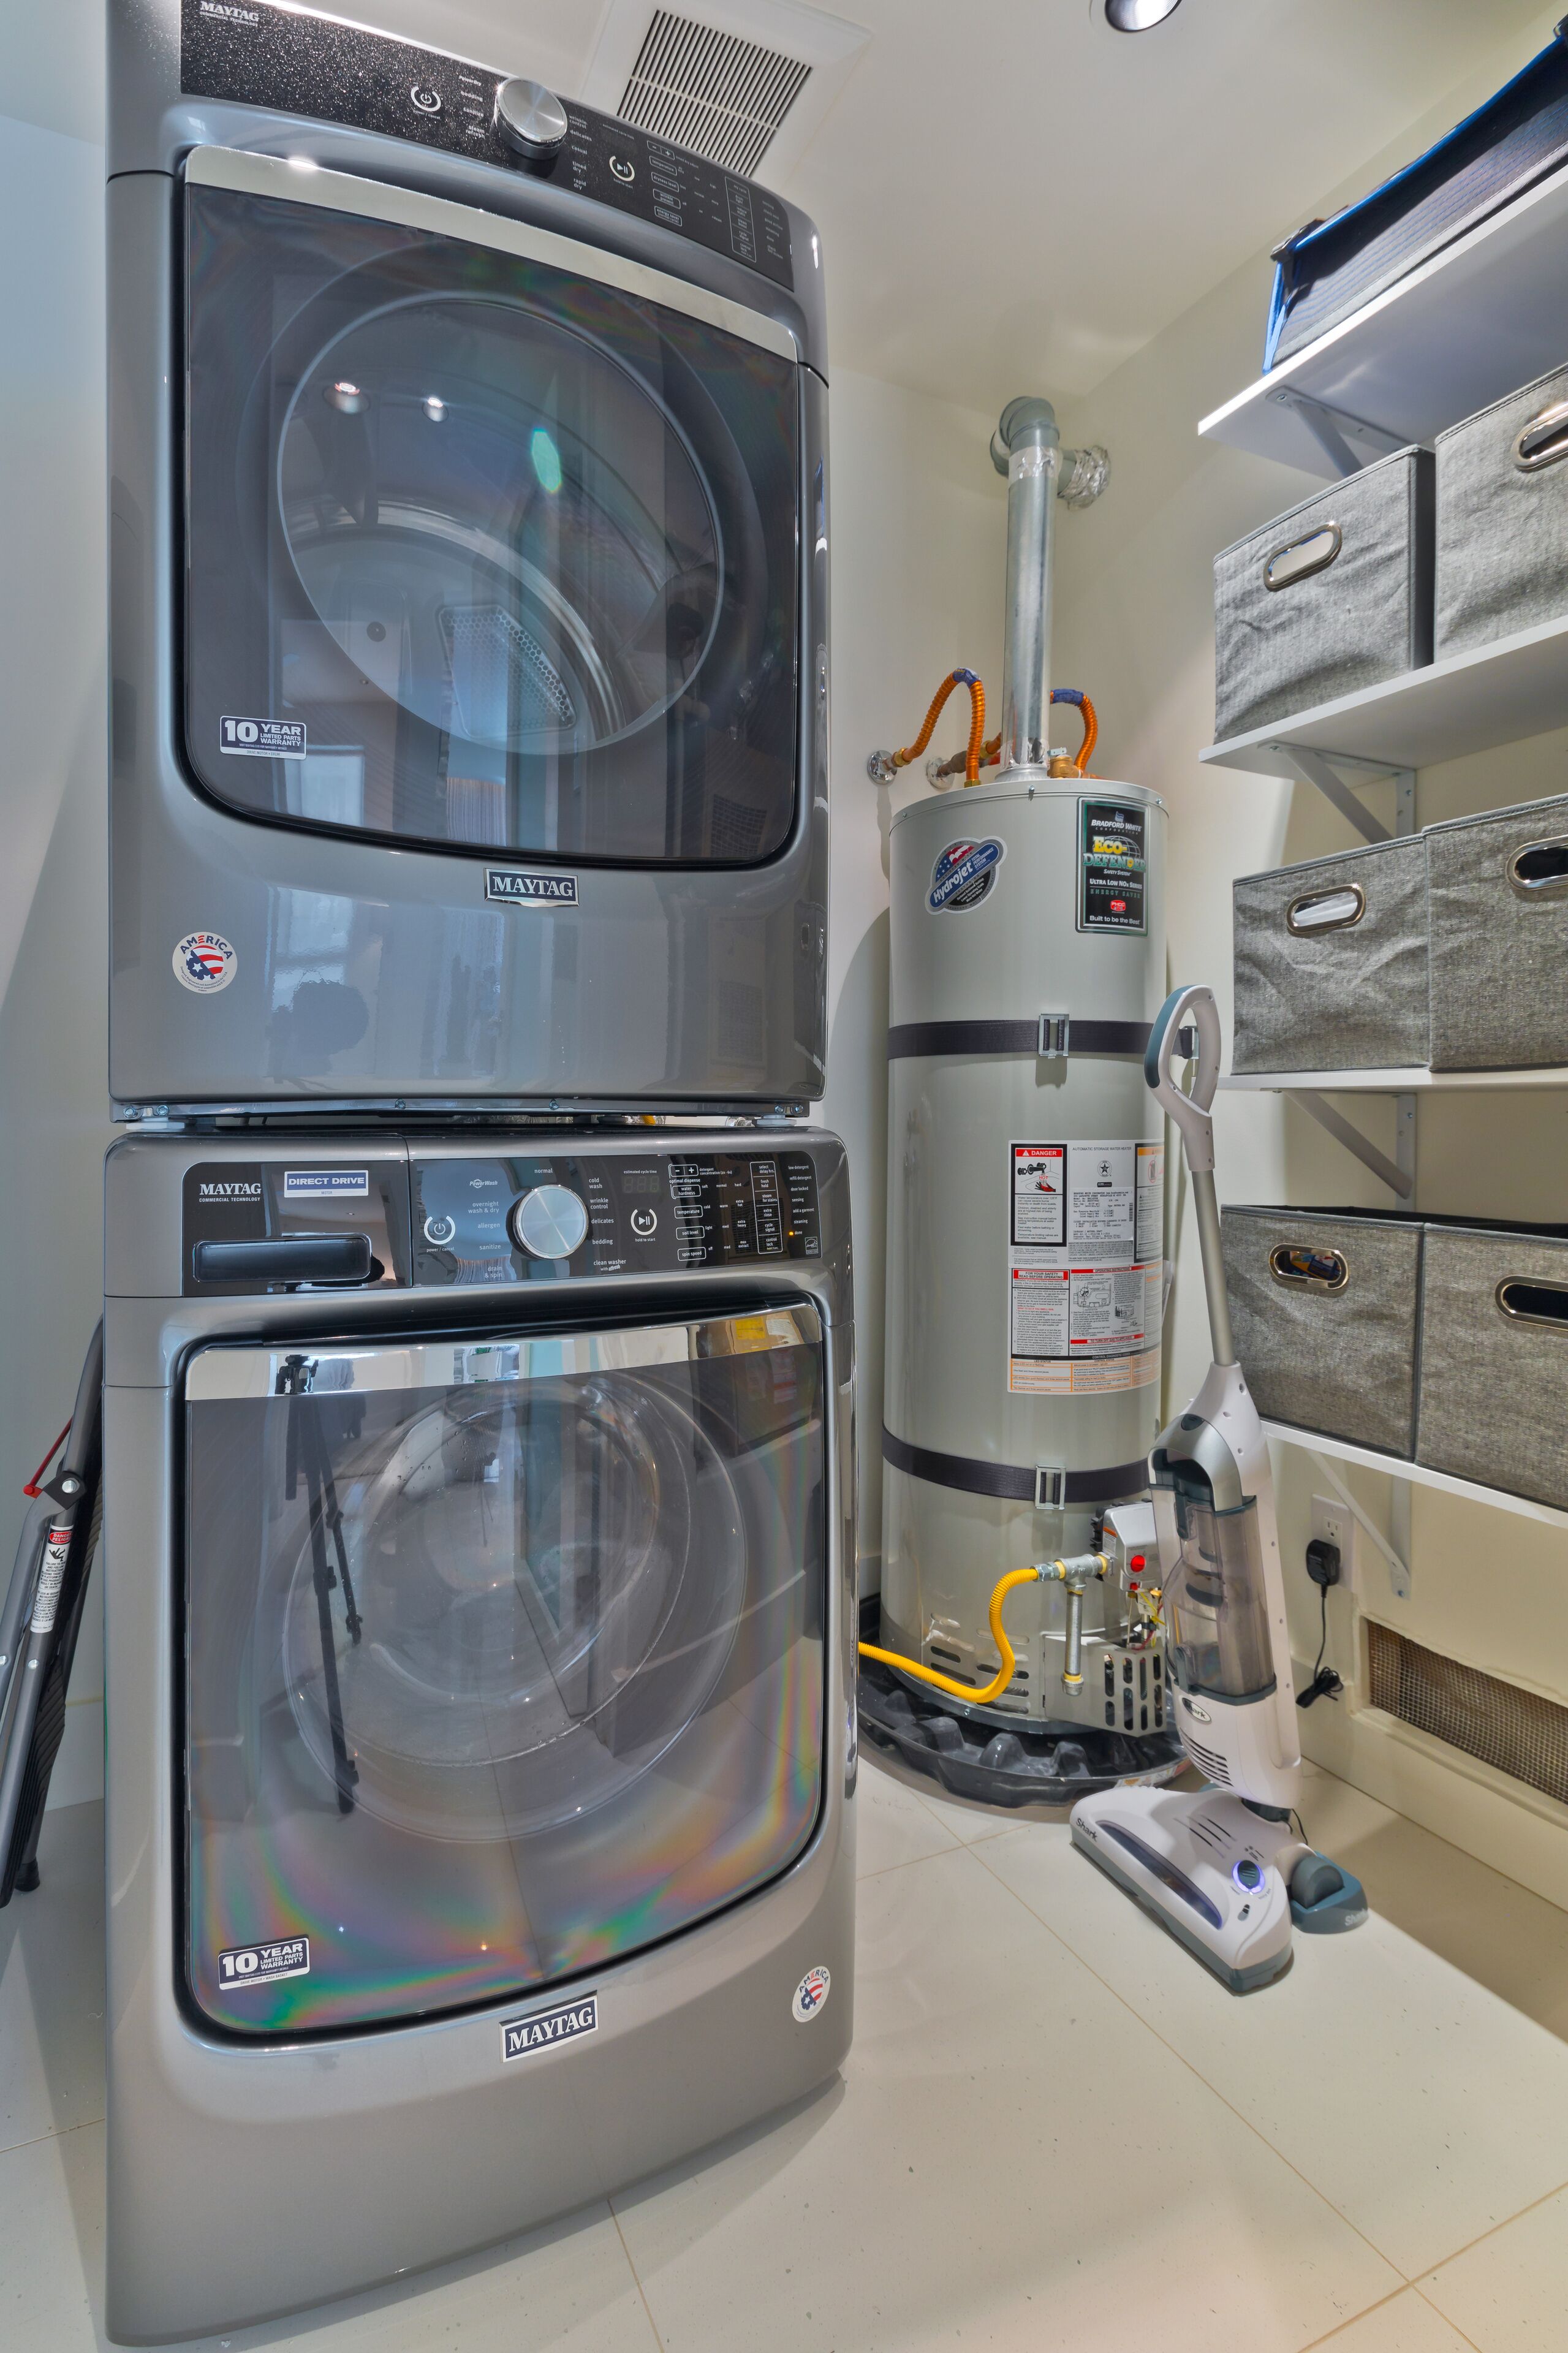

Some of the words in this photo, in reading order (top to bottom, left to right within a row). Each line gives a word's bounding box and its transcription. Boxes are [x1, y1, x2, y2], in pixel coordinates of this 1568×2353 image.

[200, 1, 259, 21] MAYTAG
[574, 178, 586, 186] rapid
[225, 720, 259, 743] 10
[260, 724, 301, 735] YEAR
[260, 738, 301, 746] WARRANTY
[1091, 819, 1124, 828] BRADFORD
[1125, 822, 1142, 832] WHITE
[1083, 853, 1146, 872] DEFENDER
[493, 876, 573, 896] MAYTAG
[933, 861, 973, 903] Hydrojet
[180, 935, 233, 960] AMERICA
[199, 1183, 262, 1195] MAYTAG
[1076, 1817, 1097, 1843] Shark
[260, 1943, 303, 1958] YEAR
[222, 1952, 258, 1977] 10
[261, 1957, 303, 1970] WARRANTY
[799, 1969, 828, 1993] AMERICA
[508, 2007, 593, 2052] MAYTAG
